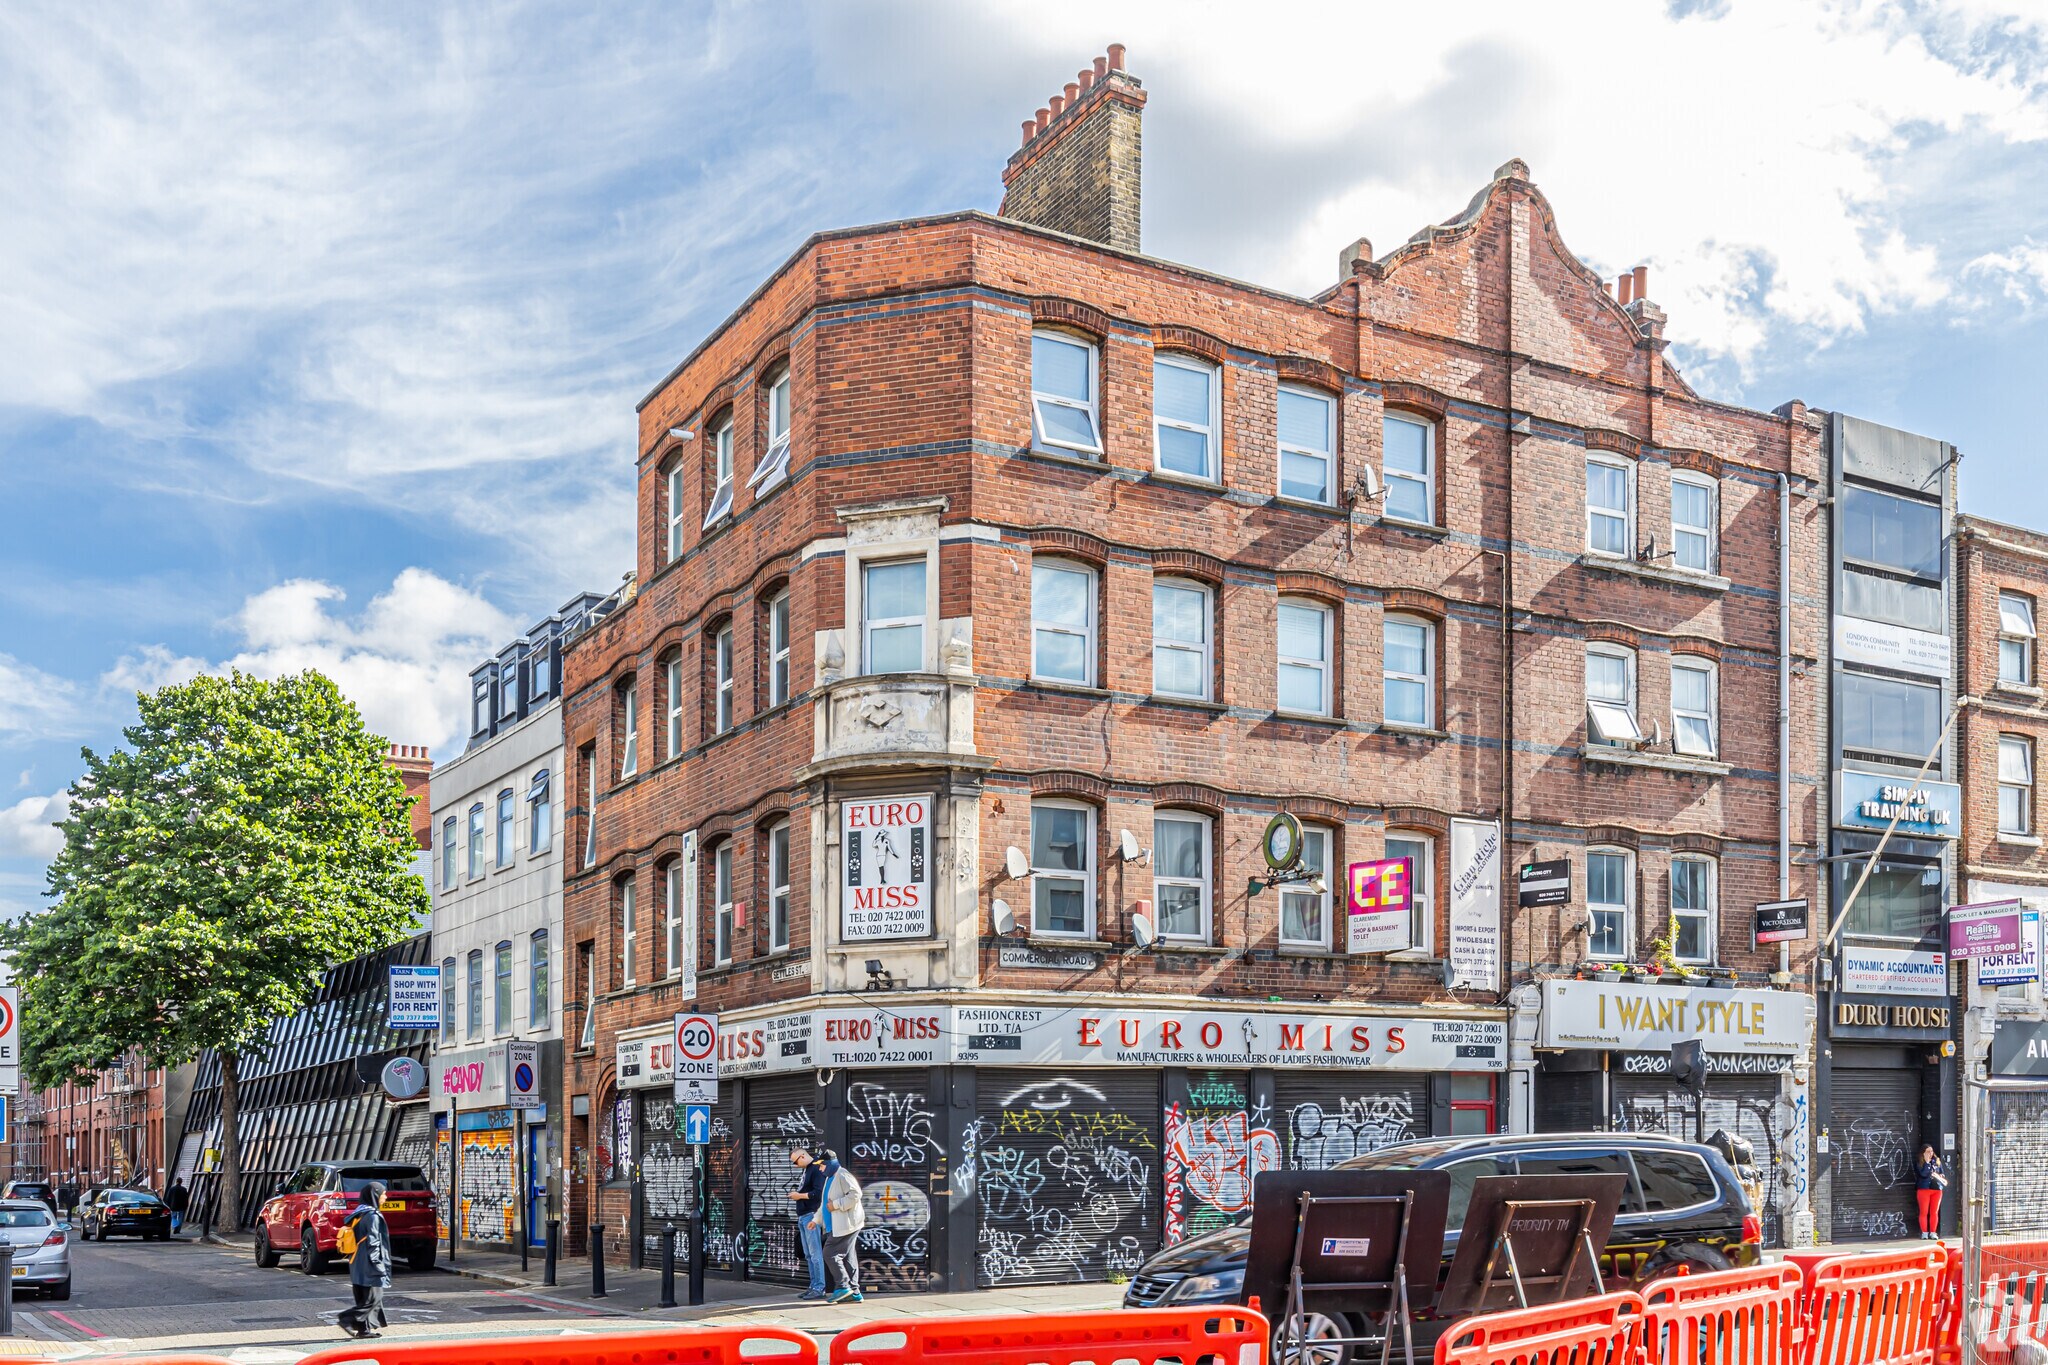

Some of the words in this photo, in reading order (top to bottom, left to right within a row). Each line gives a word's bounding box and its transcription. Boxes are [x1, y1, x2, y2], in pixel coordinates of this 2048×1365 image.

[1846, 632, 1869, 642] LONDON
[1869, 638, 1900, 648] COMMUNITY
[1884, 785, 1931, 804] SIMPLY
[848, 802, 923, 828] EURO
[1934, 809, 1950, 824] UK
[1453, 867, 1476, 893] Gian
[1474, 832, 1497, 866] Riche
[854, 885, 919, 910] MISS
[849, 913, 866, 923] TEL:
[868, 911, 882, 922] 020
[885, 911, 903, 921] 7422
[906, 910, 924, 920] 0001
[1984, 907, 2009, 915] MANAGED
[848, 925, 865, 936] FAX:
[867, 924, 882, 935] 020
[884, 924, 903, 934] 7422
[905, 922, 924, 933] 0009
[1372, 924, 1398, 932] BASEMENT
[1966, 924, 1998, 936] Reality
[1456, 936, 1495, 944] WHOLESALE
[1454, 946, 1470, 954] CASH
[1951, 948, 1968, 956] 020
[1970, 946, 1992, 954] 3355
[1994, 943, 2016, 952] 0908
[1003, 952, 1059, 965] COMMERCIAL
[1063, 955, 1087, 966] ROAD
[1982, 955, 2003, 967] FOR
[2007, 952, 2035, 965] RENT
[773, 967, 795, 980] SETTLES
[796, 965, 805, 974] ST.
[1848, 960, 1885, 972] DYNAMIC
[1887, 962, 1944, 974] ACCOUNTANTS
[1848, 973, 1878, 981] CHARTERED
[1880, 974, 1906, 982] CERTIFIED
[1907, 976, 1944, 984] ACCOUNTANTS
[395, 991, 436, 999] BASEMENT
[392, 1003, 410, 1011] FOR
[413, 1003, 437, 1011] RENT
[959, 1010, 1042, 1021] FASHIONCREST
[1598, 994, 1605, 1030] I
[1615, 996, 1688, 1032] WANT
[1696, 999, 1765, 1035] STYLE
[1840, 1004, 1889, 1026] DURU
[1893, 1006, 1950, 1028] HOUSE
[767, 1022, 776, 1031] TEL:
[777, 1019, 788, 1029] 020
[788, 1017, 799, 1028] 7422
[800, 1015, 811, 1025] 0001
[825, 1018, 872, 1041] EURO
[893, 1017, 940, 1040] MISS
[978, 1023, 1003, 1033] LTD.
[1005, 1023, 1022, 1033] T/A
[1465, 1023, 1483, 1032] 7422
[1484, 1025, 1501, 1033] 0001
[684, 1029, 710, 1047] 20
[767, 1033, 776, 1042] FAX:
[777, 1031, 788, 1041] 020
[788, 1029, 799, 1040] 7422
[800, 1027, 811, 1037] 0009
[1077, 1018, 1224, 1050] EURO
[1278, 1023, 1406, 1053] MISS
[1465, 1035, 1483, 1044] 7422
[1484, 1036, 1502, 1044] 0009
[510, 1044, 535, 1052] Controlled
[880, 1052, 905, 1062] 7422
[908, 1051, 933, 1061] 0001
[958, 1053, 979, 1061] 93/95
[1117, 1051, 1194, 1063] MANUFACTURERS
[1196, 1053, 1203, 1063] &
[1206, 1053, 1267, 1063] WHOLESALERS
[1269, 1055, 1280, 1063] OF
[1282, 1055, 1311, 1064] LADIES
[1313, 1055, 1371, 1065] FASHIONWEAR
[680, 1062, 713, 1073] ZONE
[720, 1065, 736, 1074] LADIES
[736, 1061, 767, 1073] FASHIONWEAR
[443, 1062, 484, 1094] #CANDY
[1510, 1219, 1554, 1232] PRIORITY
[1556, 1219, 1570, 1231] TM
